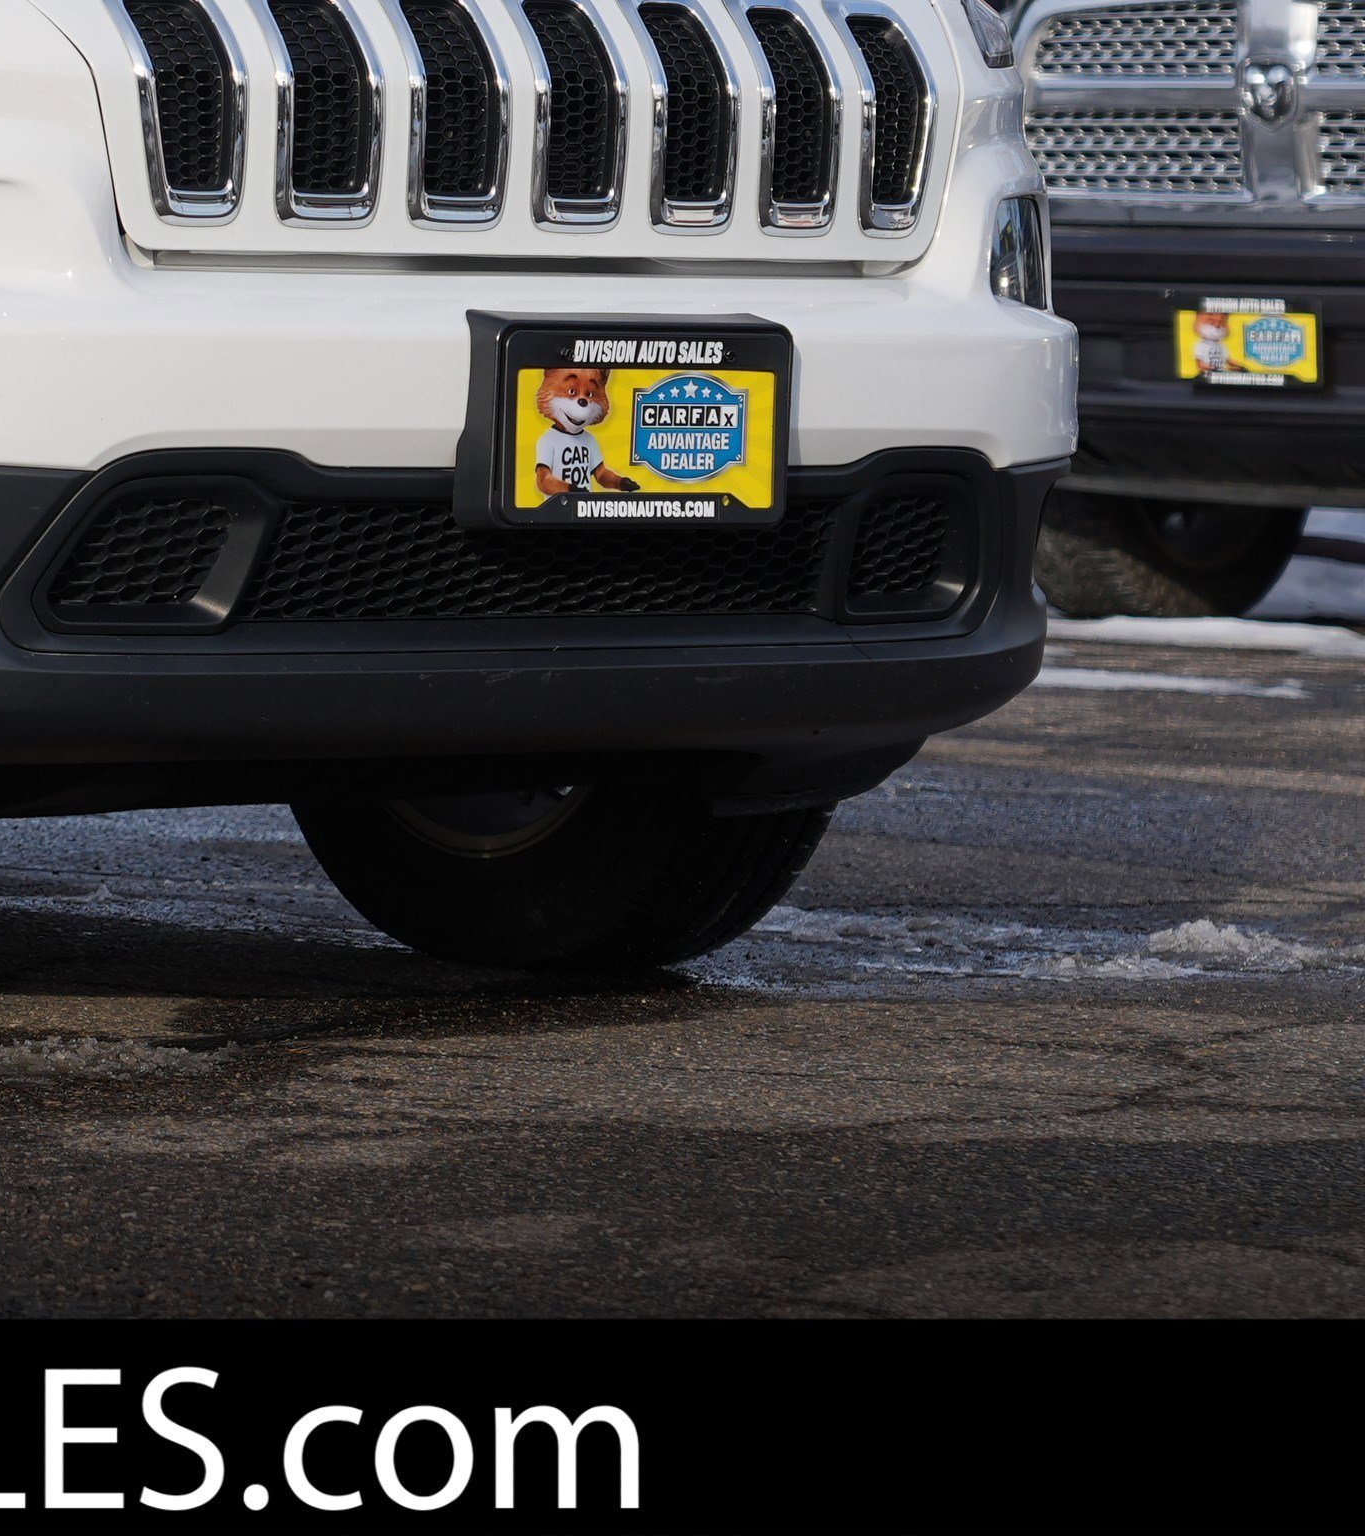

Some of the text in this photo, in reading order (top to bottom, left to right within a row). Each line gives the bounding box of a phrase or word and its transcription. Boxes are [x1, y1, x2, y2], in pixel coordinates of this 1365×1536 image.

[573, 340, 724, 364] DIVISION AUTO SALES
[643, 406, 735, 427] CARFAX
[647, 432, 730, 450] ADVANTAGE
[561, 446, 589, 465] CAR
[660, 452, 715, 470] DEALER
[562, 465, 590, 485] FOX
[577, 500, 716, 518] DIVISIONAUTOS.COM
